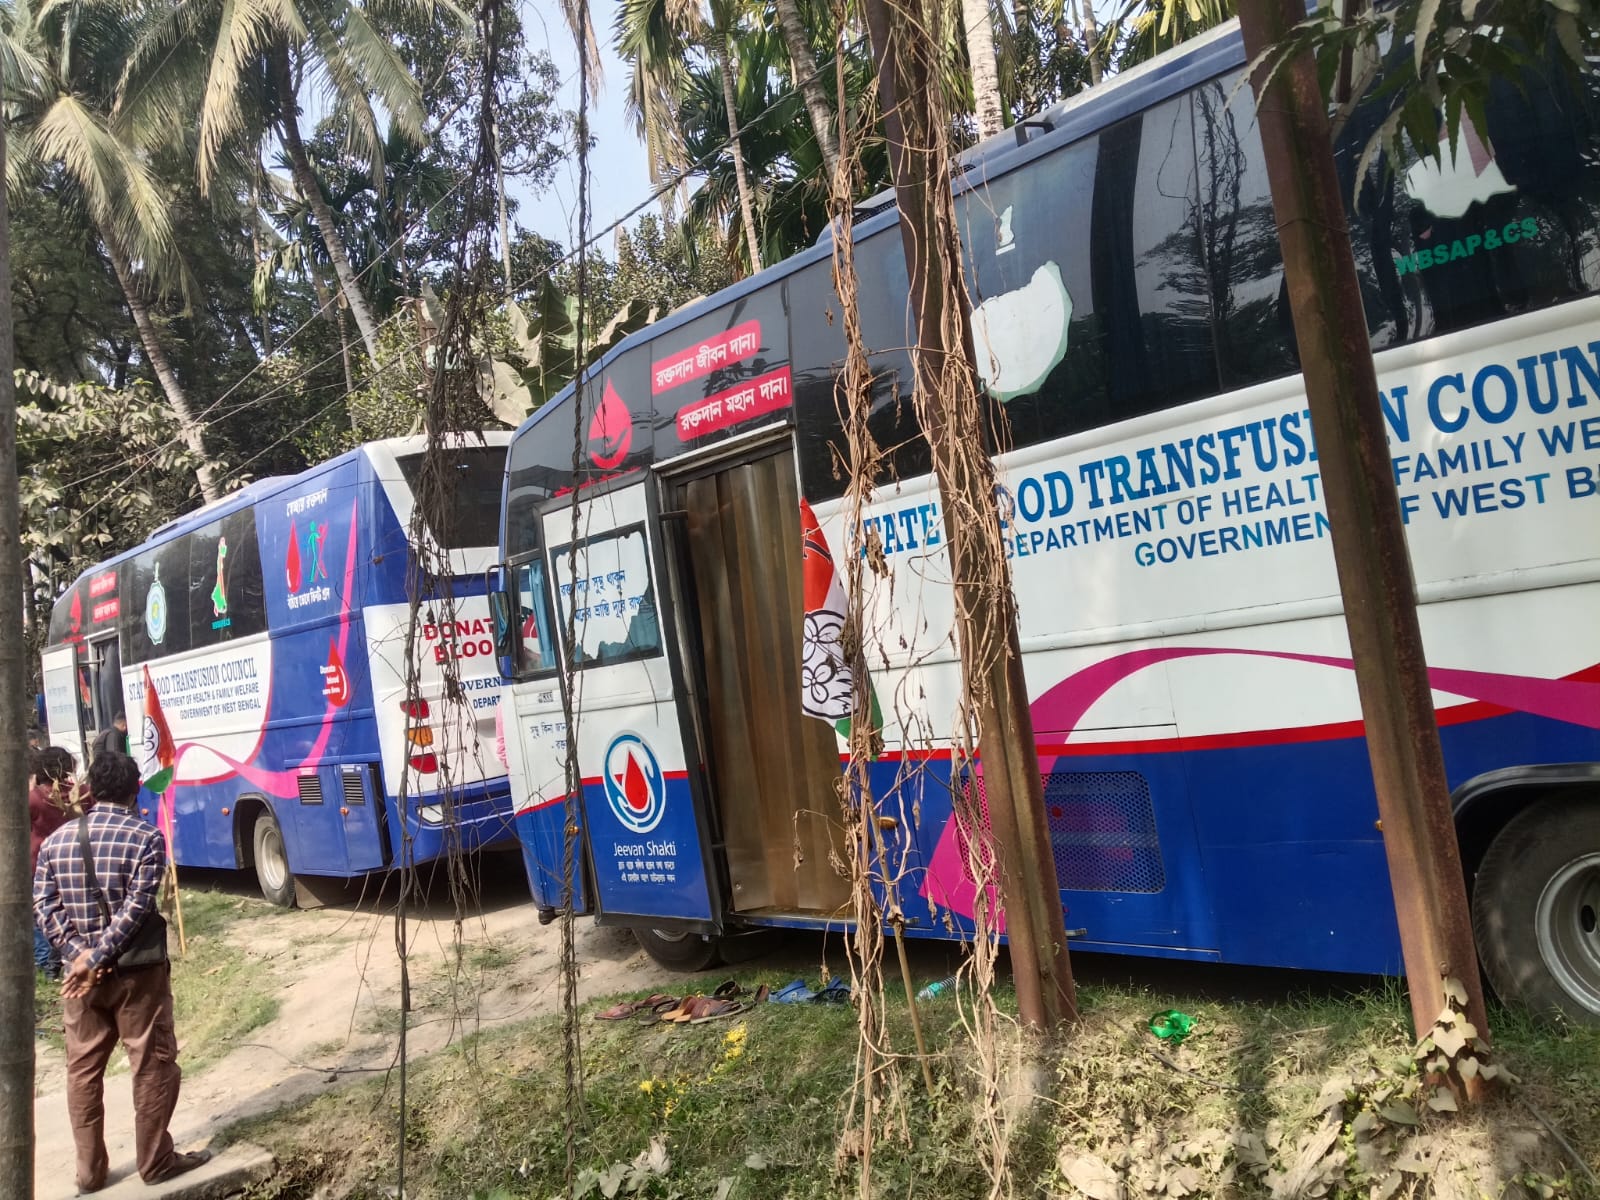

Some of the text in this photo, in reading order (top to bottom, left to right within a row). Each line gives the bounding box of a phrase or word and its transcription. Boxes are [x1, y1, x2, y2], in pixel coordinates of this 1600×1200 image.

[1394, 216, 1538, 275] WBSAP&CS
[656, 358, 694, 387] রক্তদান
[696, 345, 727, 369] জীবন
[680, 400, 722, 431] রক্তদান
[725, 387, 755, 414] মহান
[850, 502, 941, 561] TATE
[992, 469, 1074, 529] OOD
[1079, 385, 1410, 510] TRANSFUSIN
[1177, 495, 1212, 526] OF
[1222, 473, 1320, 517] HEALT
[1393, 431, 1526, 486] FAMILY
[1135, 511, 1331, 567] GOVERNMEN
[1432, 472, 1550, 519] WEST
[423, 618, 494, 641] DONAT
[434, 640, 493, 663] BLOO
[128, 680, 144, 701] STAT
[171, 664, 219, 693] TRANSFUSION
[221, 656, 257, 684] COUNCIL
[161, 695, 185, 709] EPARTMENT
[193, 691, 211, 704] HEALTH
[216, 686, 234, 699] FAMILY
[234, 681, 260, 697] WELFARE
[180, 696, 261, 720] GOVERNMENT OF WEST BENGAL
[473, 695, 501, 709] DEPART
[613, 839, 677, 857] Jeevan Shakti
